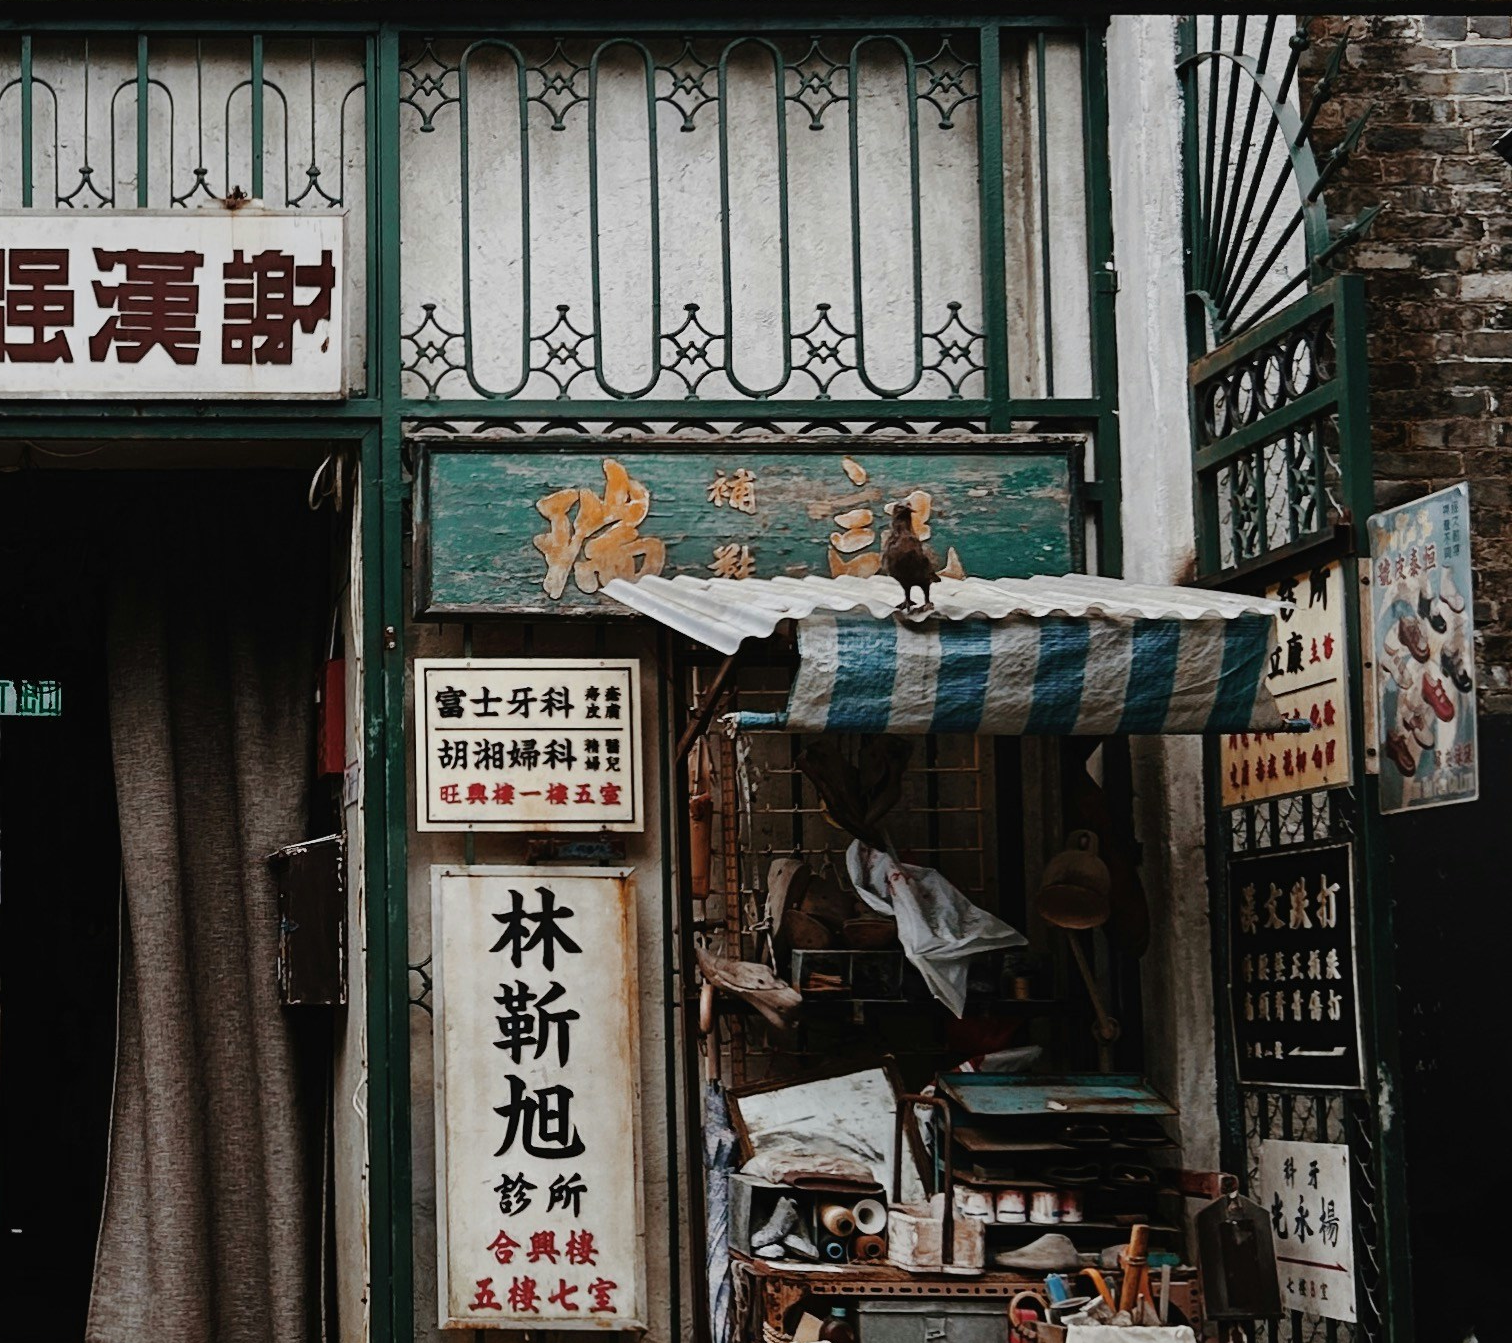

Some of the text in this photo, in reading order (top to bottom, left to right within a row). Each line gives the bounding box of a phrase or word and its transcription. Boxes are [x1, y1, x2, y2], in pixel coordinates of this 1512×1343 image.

[435, 686, 575, 719] 富士牙科
[440, 782, 621, 806] 旺興樓一樓五室
[493, 1173, 589, 1217] 診所
[486, 1228, 599, 1267] 合興樓
[467, 1276, 619, 1314] 五樓七室
